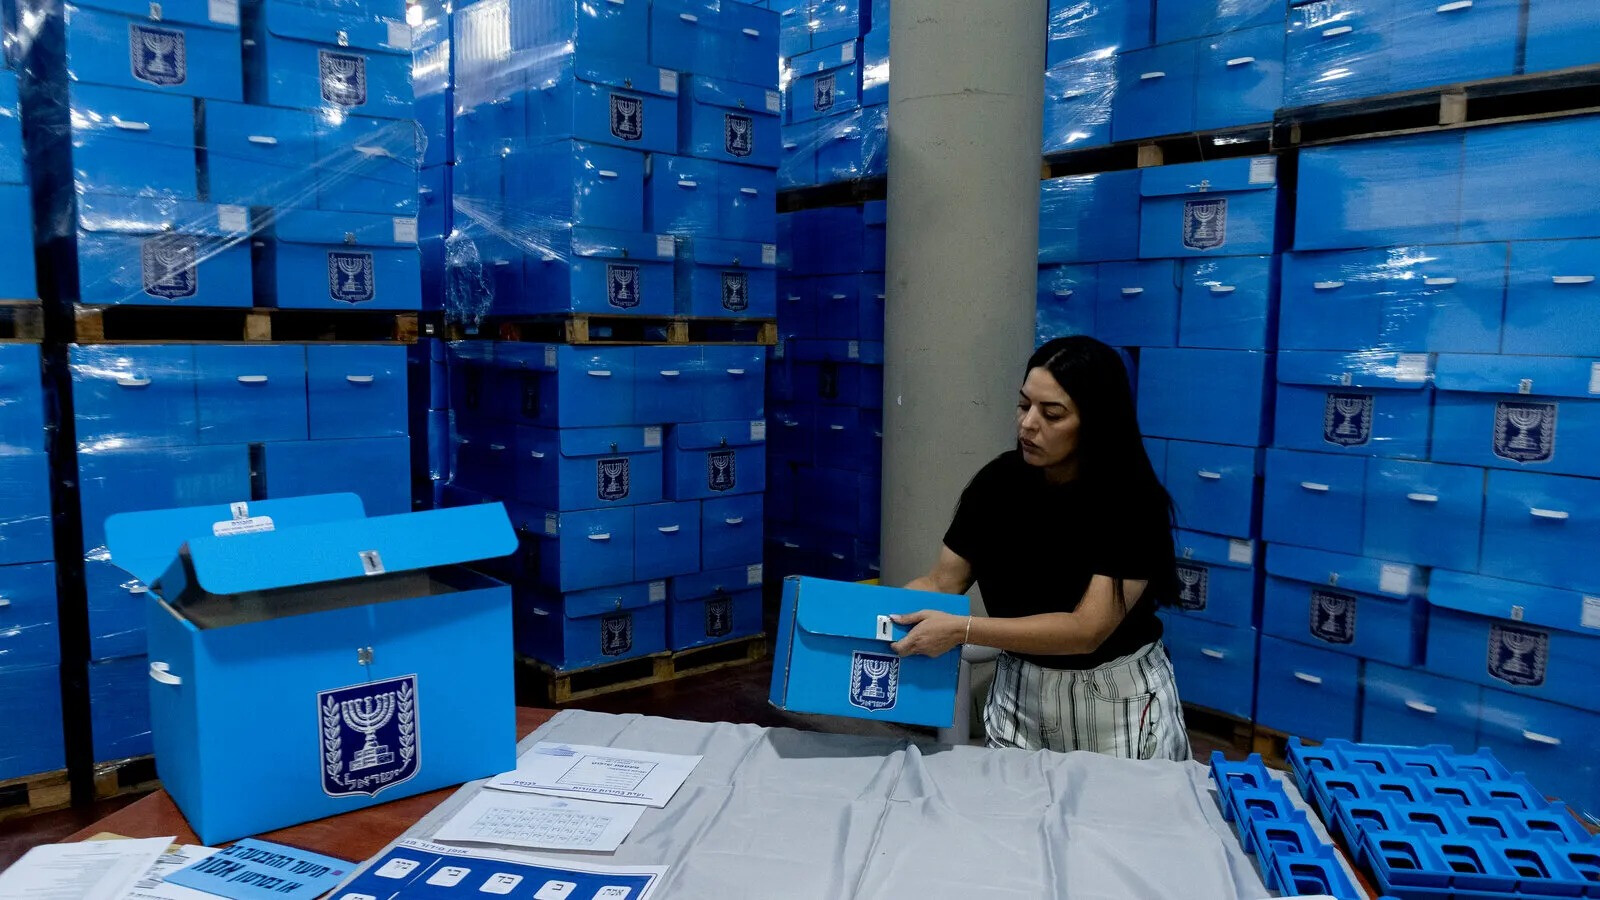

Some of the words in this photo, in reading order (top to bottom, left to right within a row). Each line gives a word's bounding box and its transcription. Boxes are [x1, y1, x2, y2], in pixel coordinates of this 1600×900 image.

[344, 769, 400, 790] ישראל
[191, 856, 246, 878] אסור
[234, 848, 295, 868] ההצבעה
[288, 860, 331, 878] תיעוד
[226, 871, 285, 890] בסרטון
[275, 882, 304, 893] או
